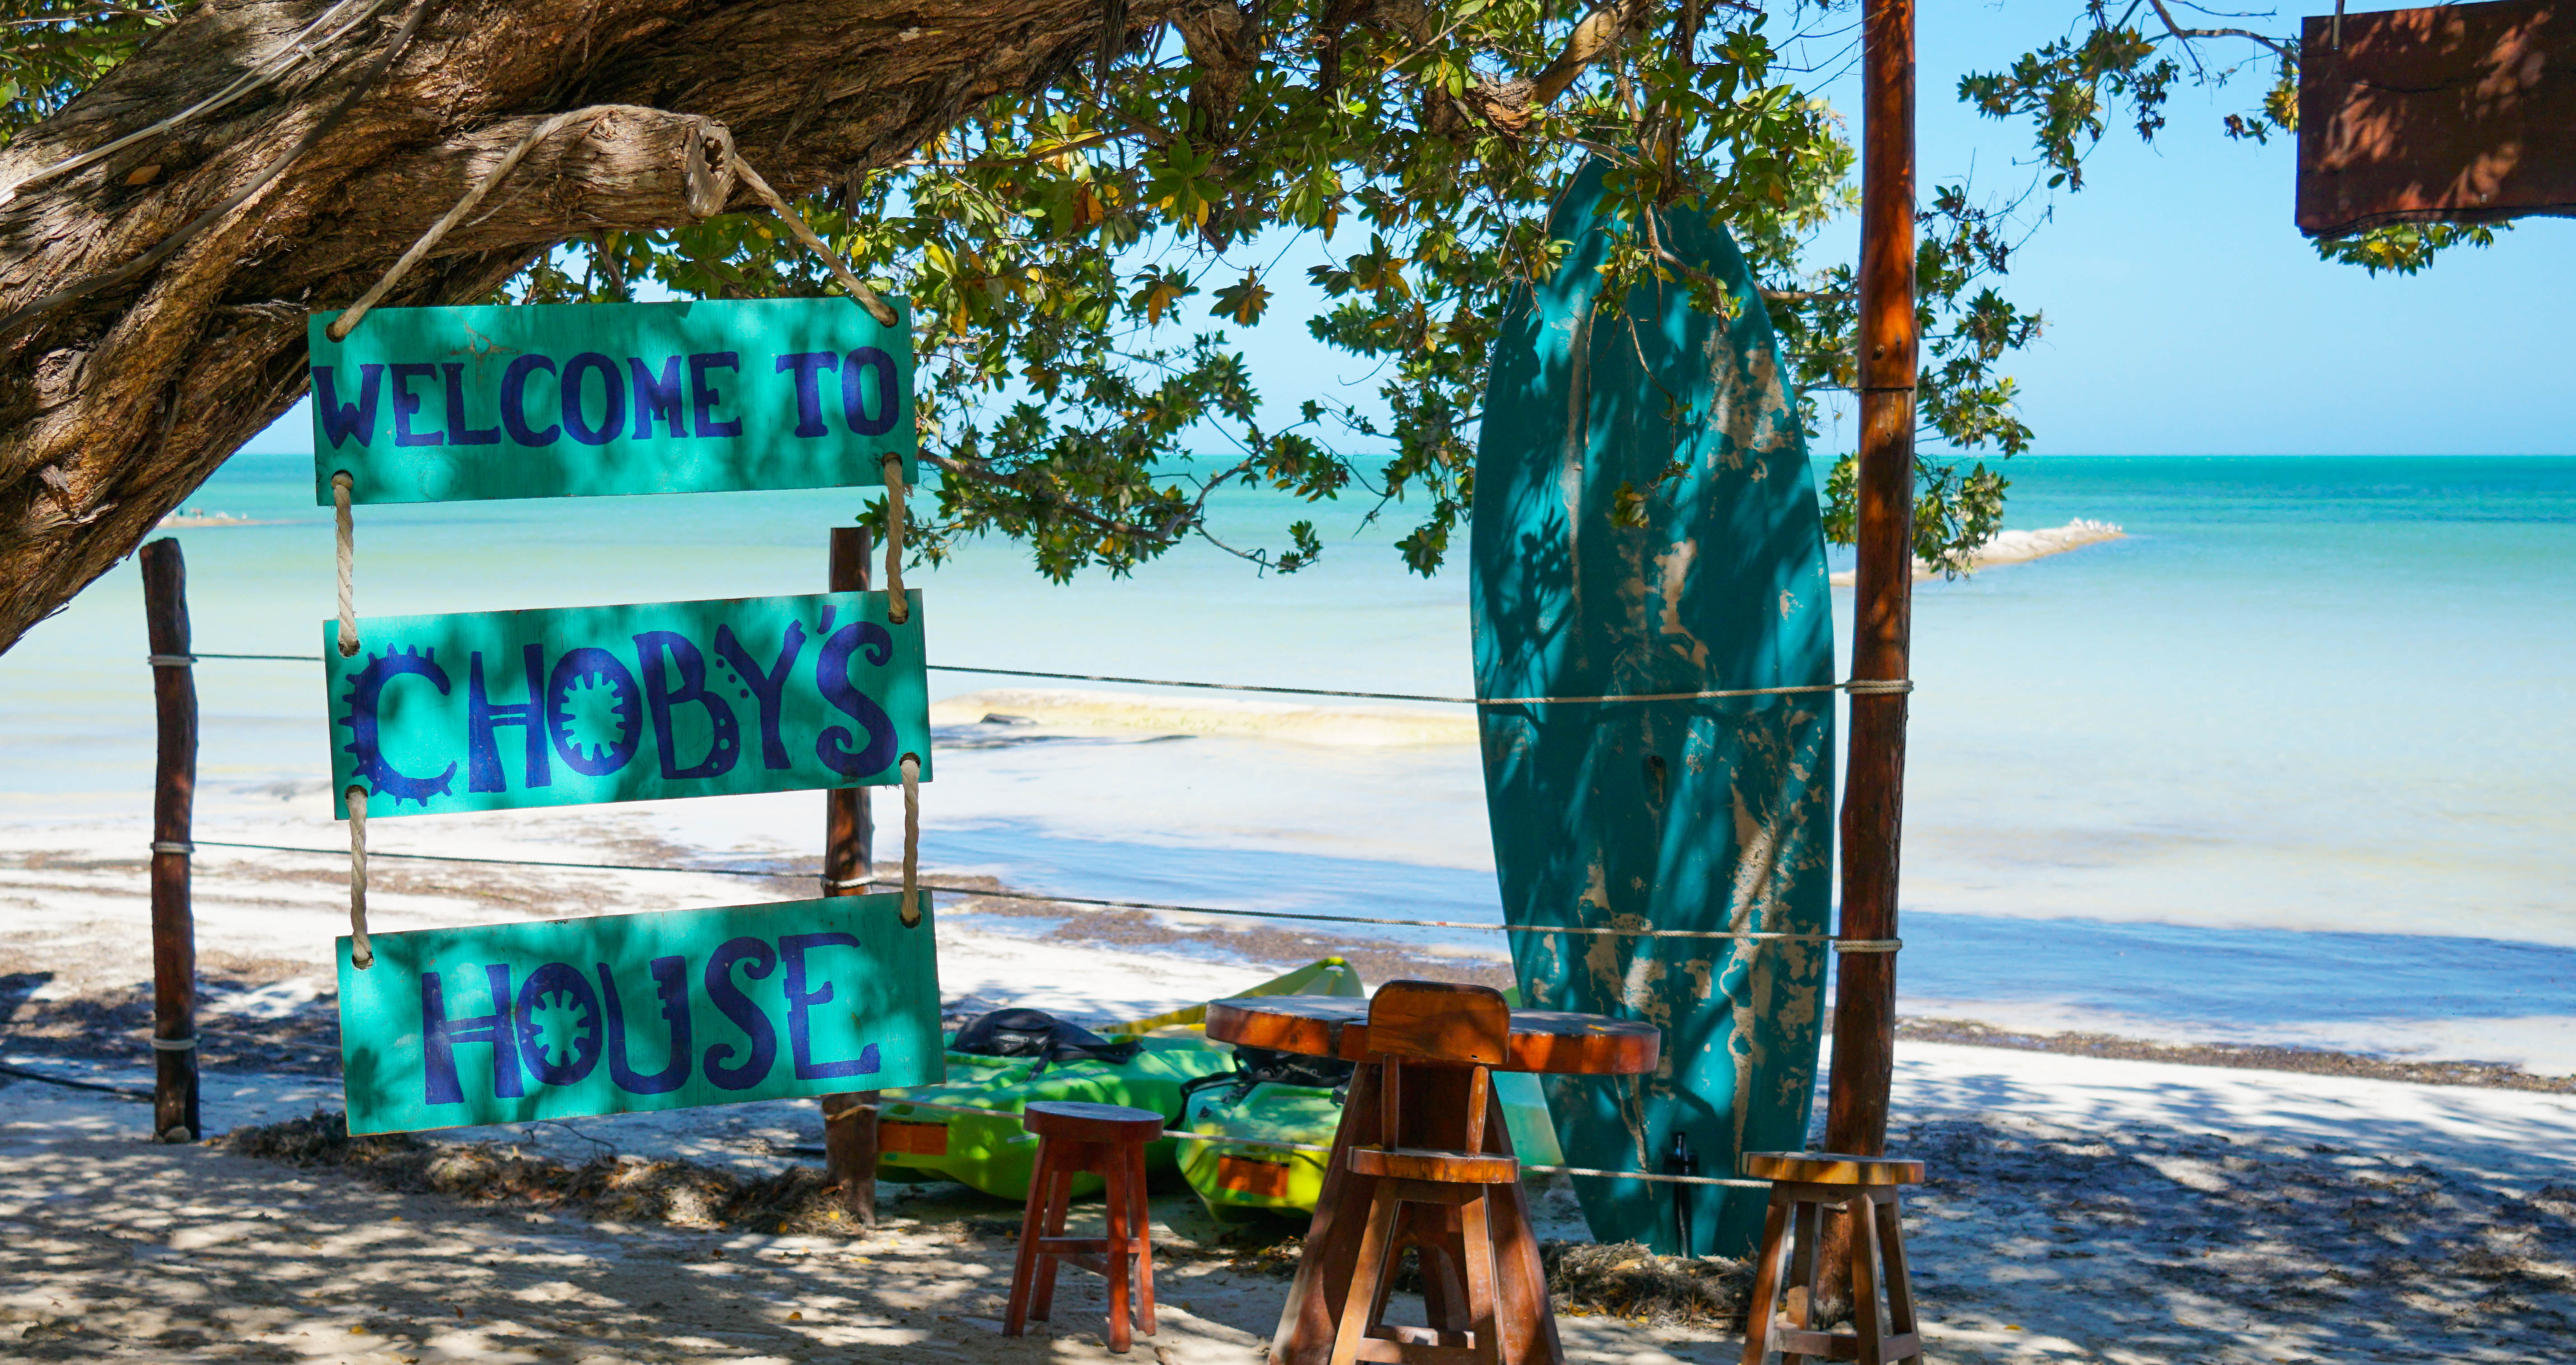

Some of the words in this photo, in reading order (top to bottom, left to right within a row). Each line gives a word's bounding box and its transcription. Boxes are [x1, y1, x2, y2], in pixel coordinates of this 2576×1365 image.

[311, 352, 742, 449] WELCOME
[776, 346, 899, 439] TO
[337, 605, 899, 807] CHOBY'S
[421, 932, 881, 1105] HOUSE
